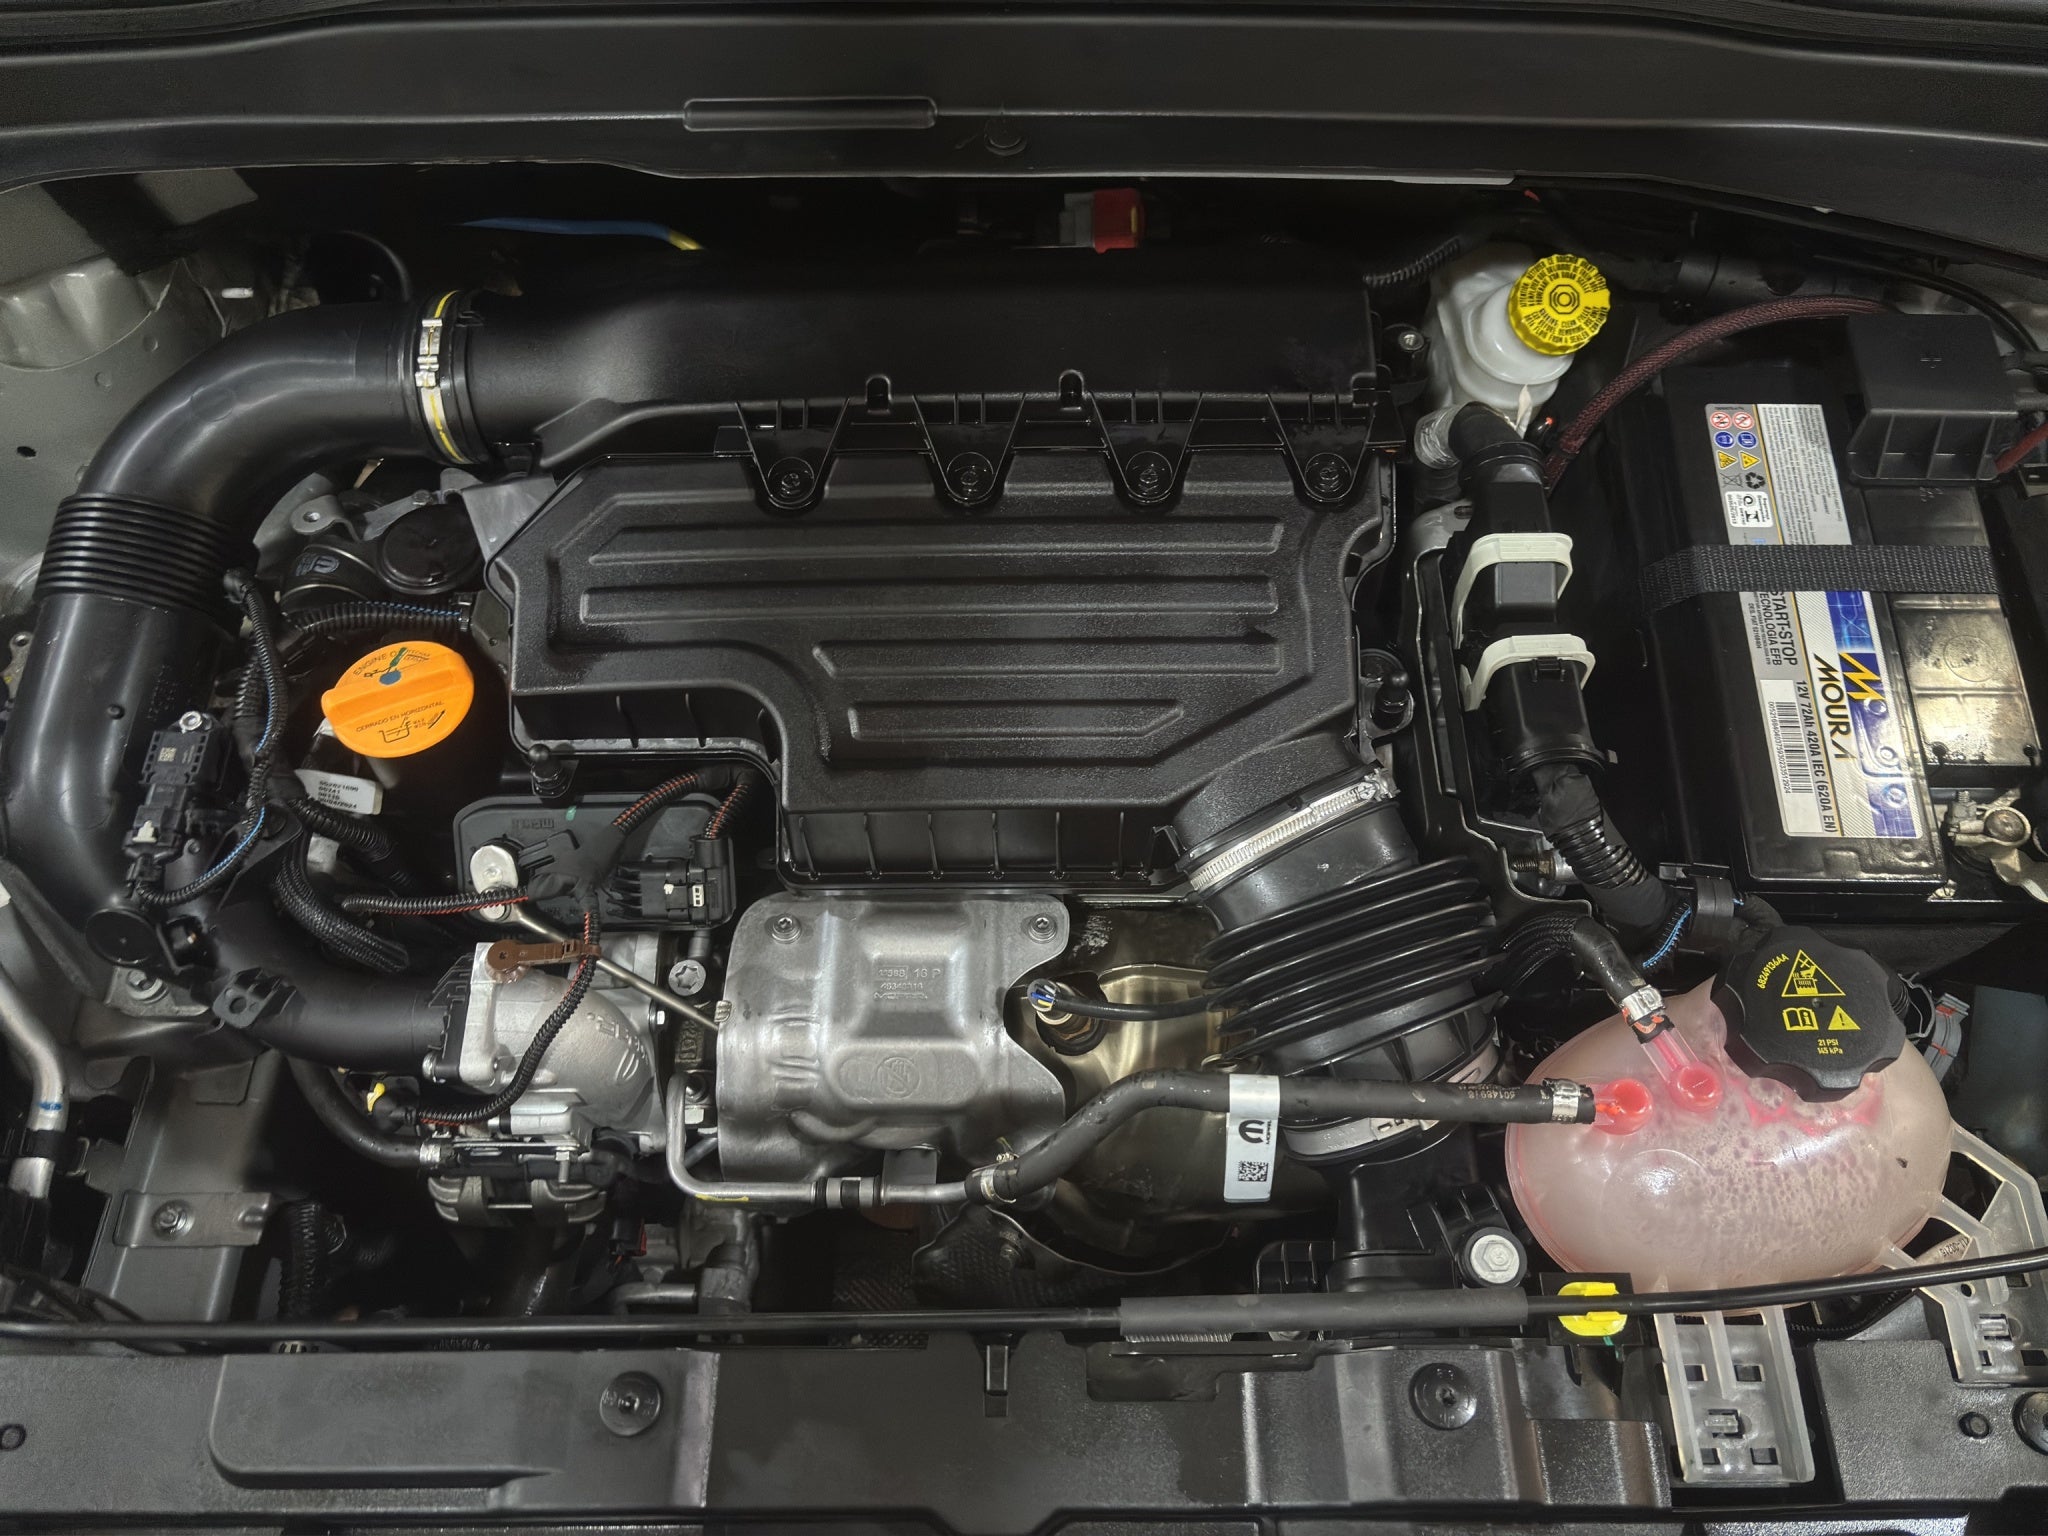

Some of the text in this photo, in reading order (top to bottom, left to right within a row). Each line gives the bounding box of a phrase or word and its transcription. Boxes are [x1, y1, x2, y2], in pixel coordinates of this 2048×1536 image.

[352, 652, 387, 676] ENGINE
[1760, 592, 1782, 666] ECNOLOGIA EFB
[356, 717, 389, 732] CERRADO
[400, 700, 444, 718] HORIZONTAL
[1813, 653, 1856, 758] MOURA
[1796, 680, 1838, 832] 12V 72Ah 420A IEC (620A EN)
